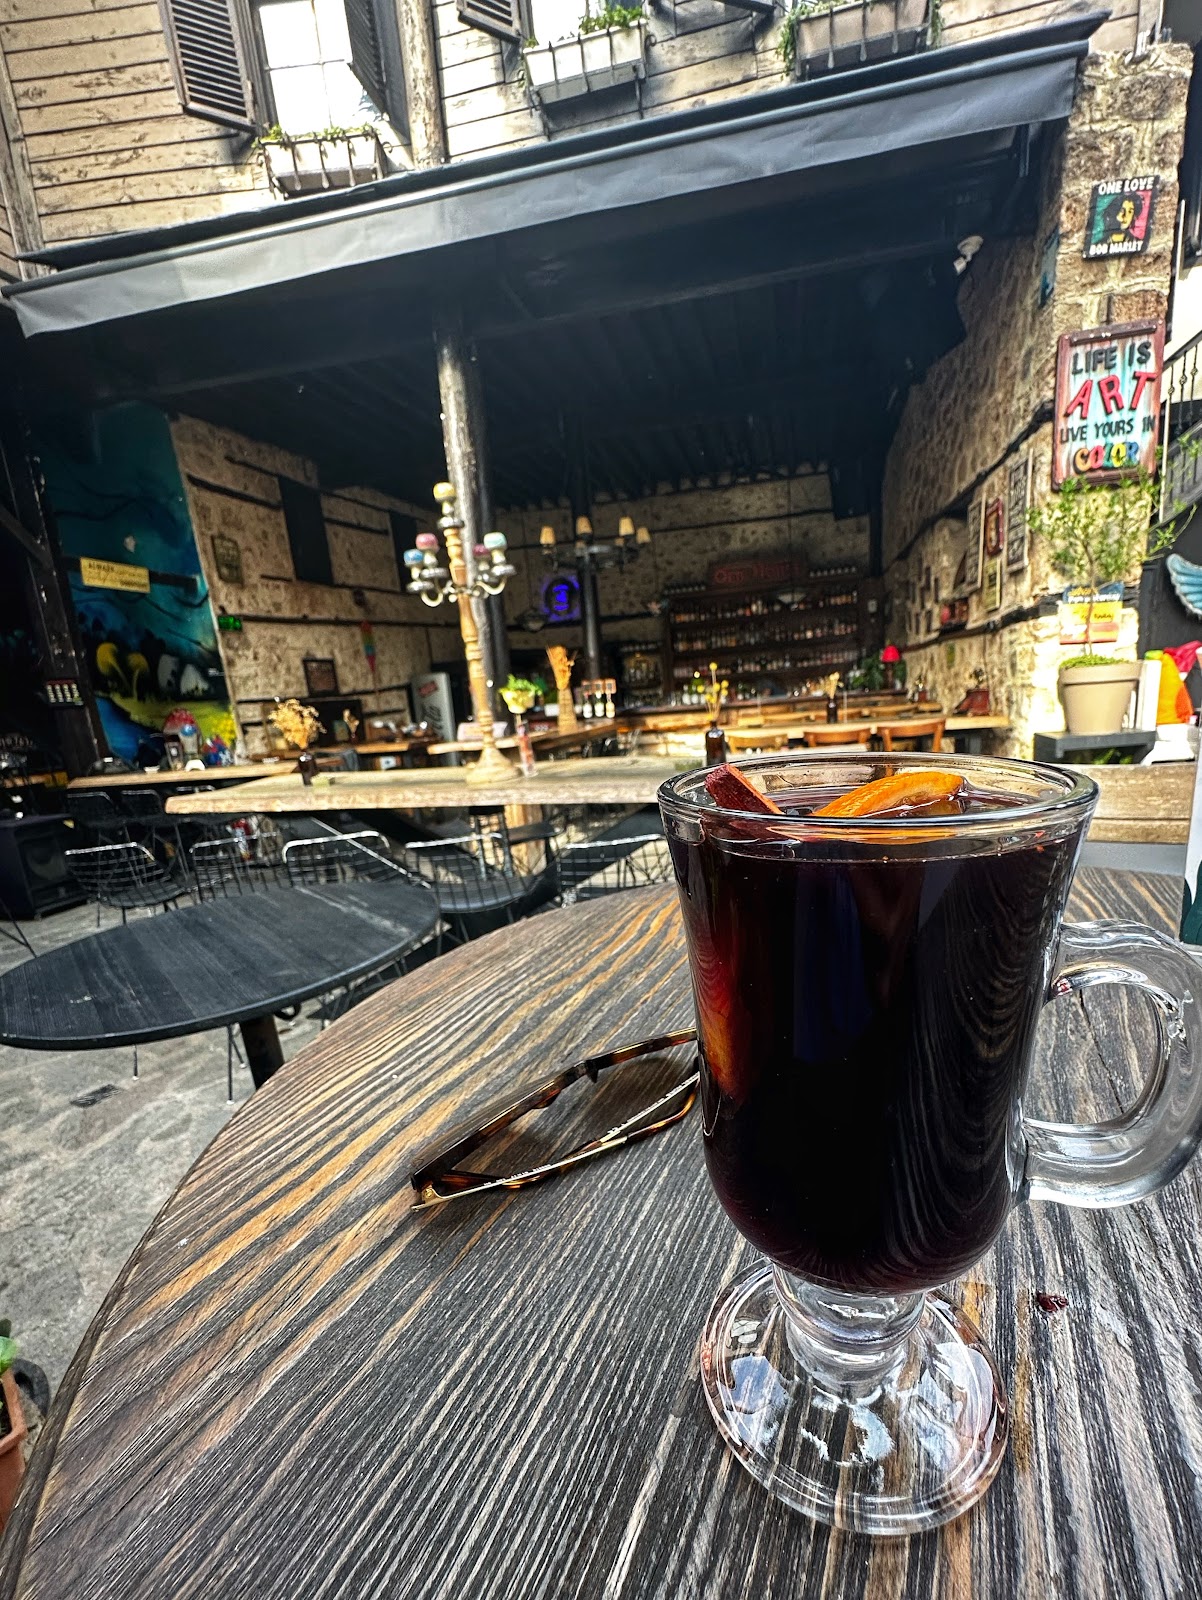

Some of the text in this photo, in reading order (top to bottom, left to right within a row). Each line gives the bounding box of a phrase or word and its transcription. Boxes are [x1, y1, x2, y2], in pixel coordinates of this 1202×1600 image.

[1098, 176, 1154, 196] ONE LOVE
[1089, 240, 1143, 256] BOB MARLEY
[1072, 341, 1151, 375] LIFE IS
[1063, 371, 1157, 420] ART
[1060, 415, 1156, 444] LIVE YOURS IN
[1073, 441, 1139, 475] COLOR
